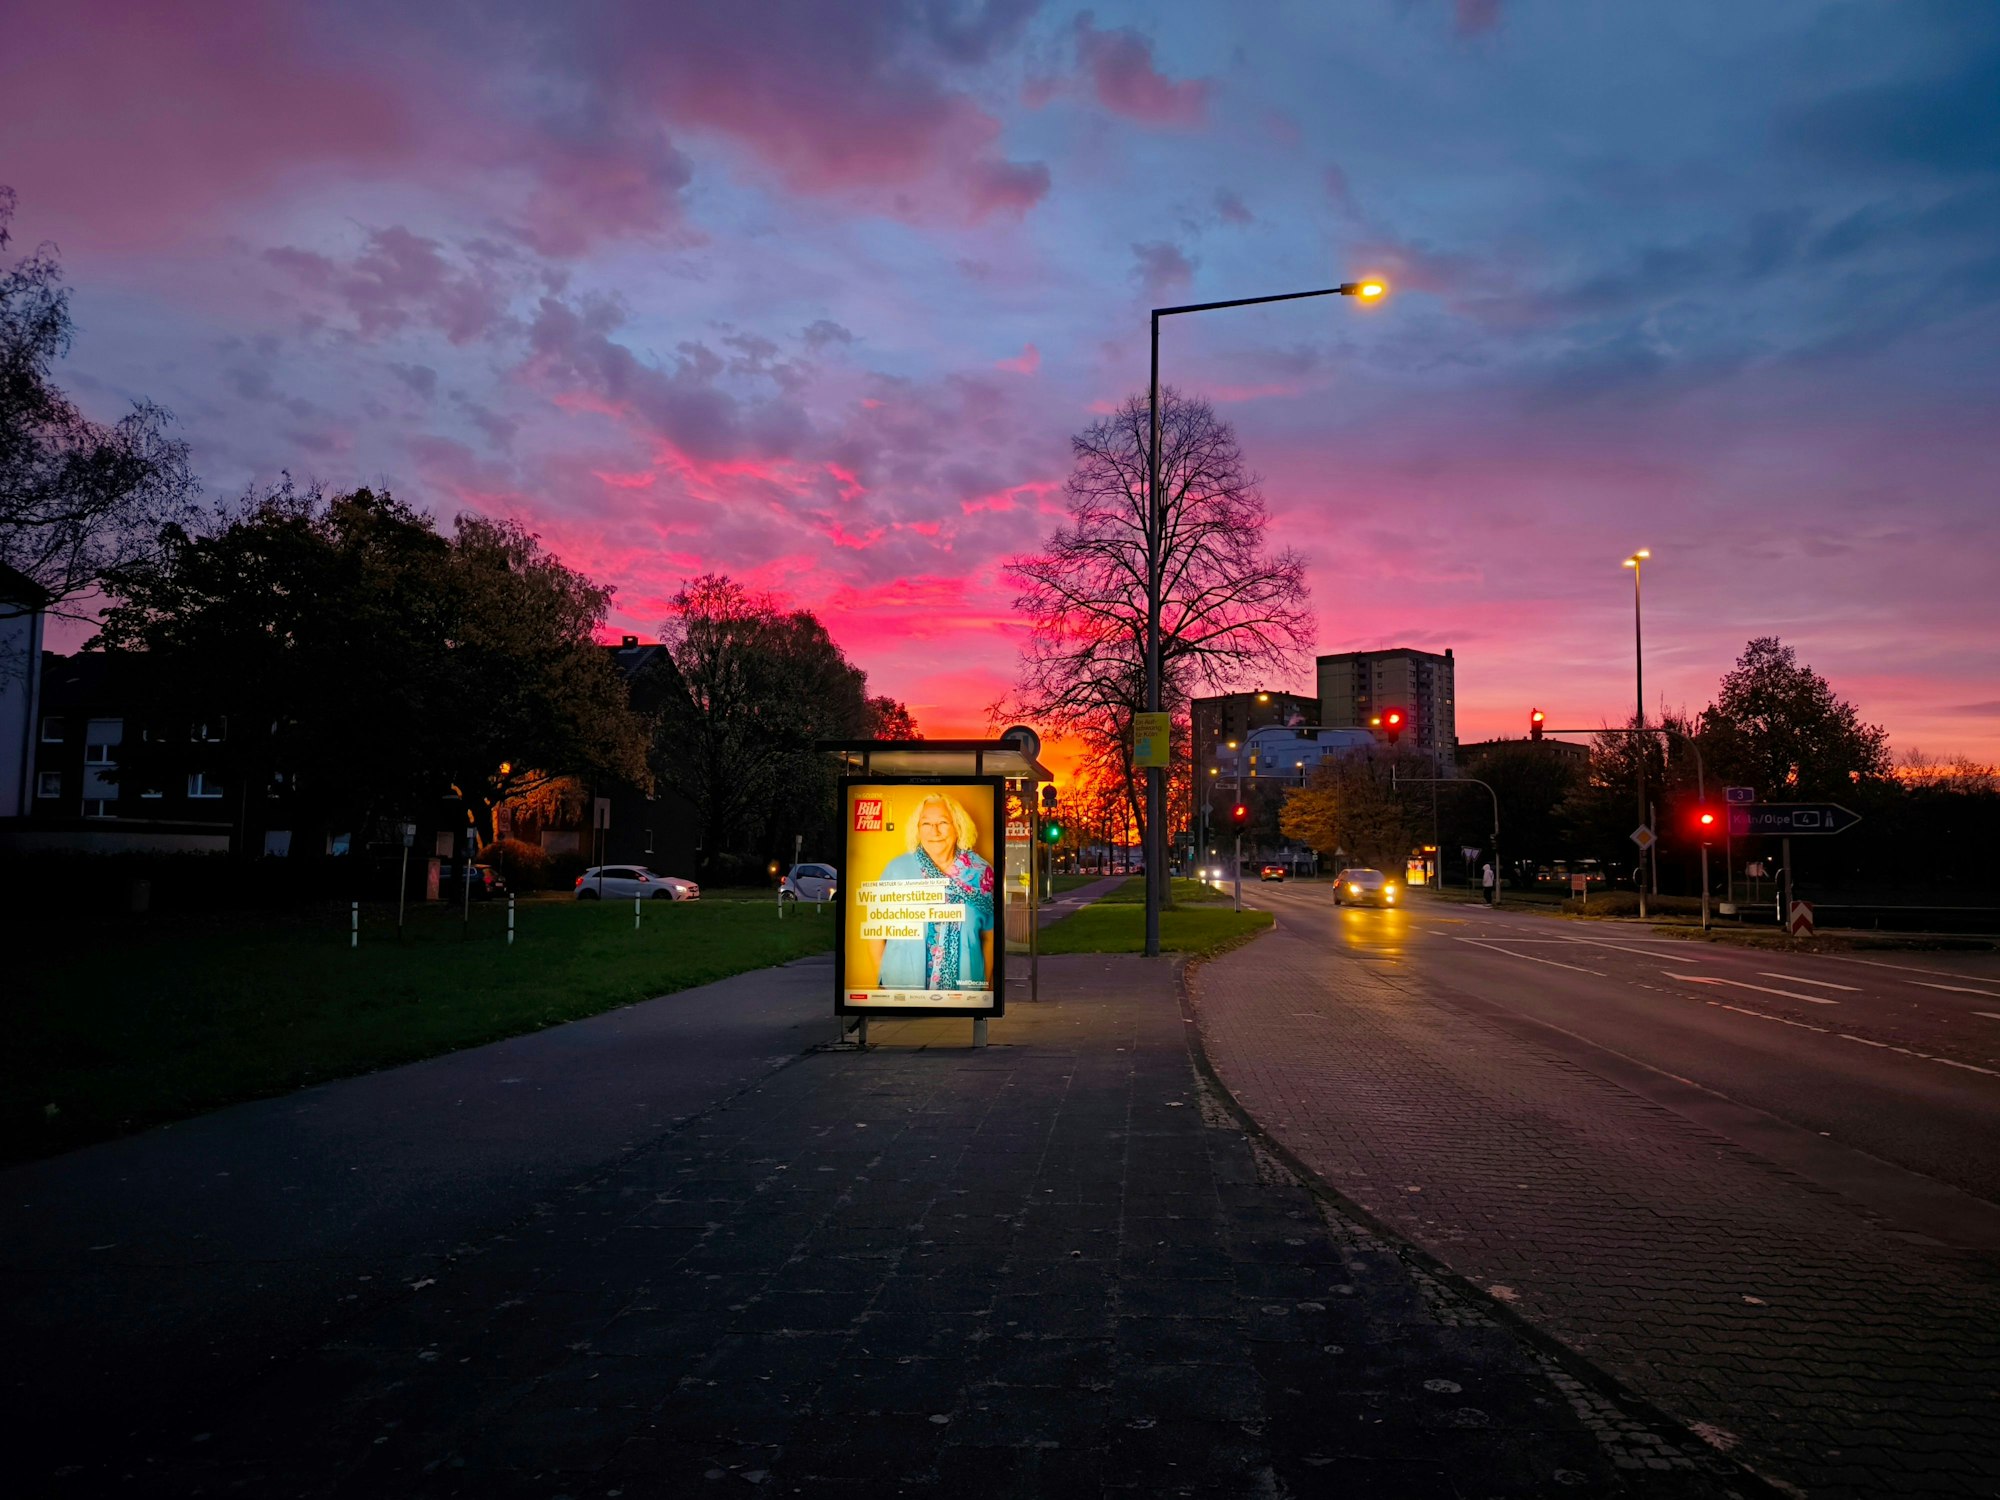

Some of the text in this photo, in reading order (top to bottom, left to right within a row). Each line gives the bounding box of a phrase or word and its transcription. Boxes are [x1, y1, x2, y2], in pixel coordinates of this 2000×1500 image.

[1737, 790, 1744, 799] 3
[856, 801, 882, 815] Bild
[856, 816, 881, 830] Frau
[1733, 814, 1810, 826] Kln/Olpe 4
[858, 890, 943, 903] Wir unterstützen
[870, 908, 962, 920] obdachlose Frauen
[863, 925, 920, 937] und Kinder.
